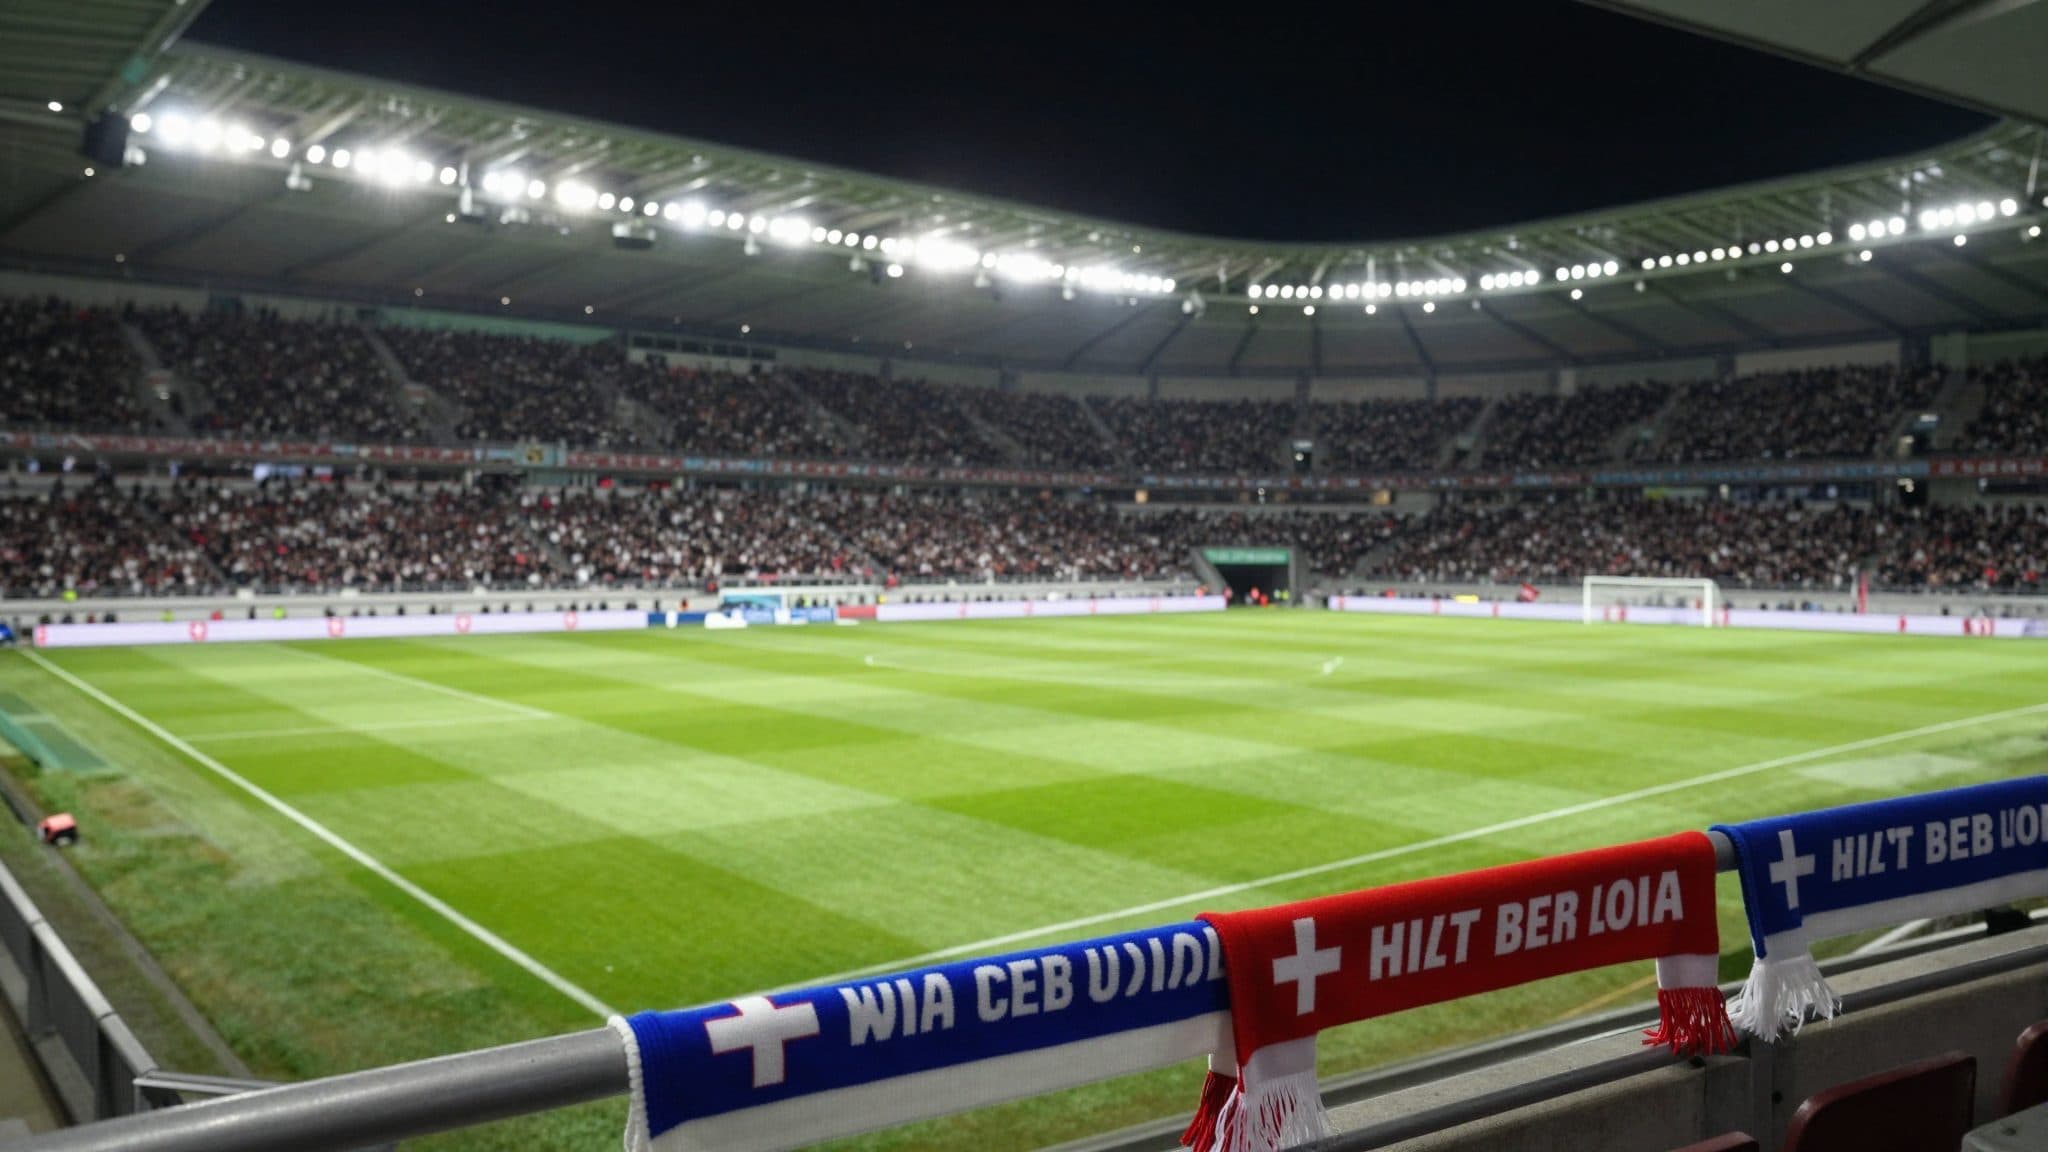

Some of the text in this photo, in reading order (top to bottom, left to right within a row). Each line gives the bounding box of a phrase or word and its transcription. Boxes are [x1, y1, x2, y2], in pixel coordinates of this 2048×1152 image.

[1925, 813, 1994, 865] BEB
[1369, 870, 1684, 981] HILT BER LOIA
[838, 972, 955, 1047] WIA
[973, 954, 1074, 1022] CEB
